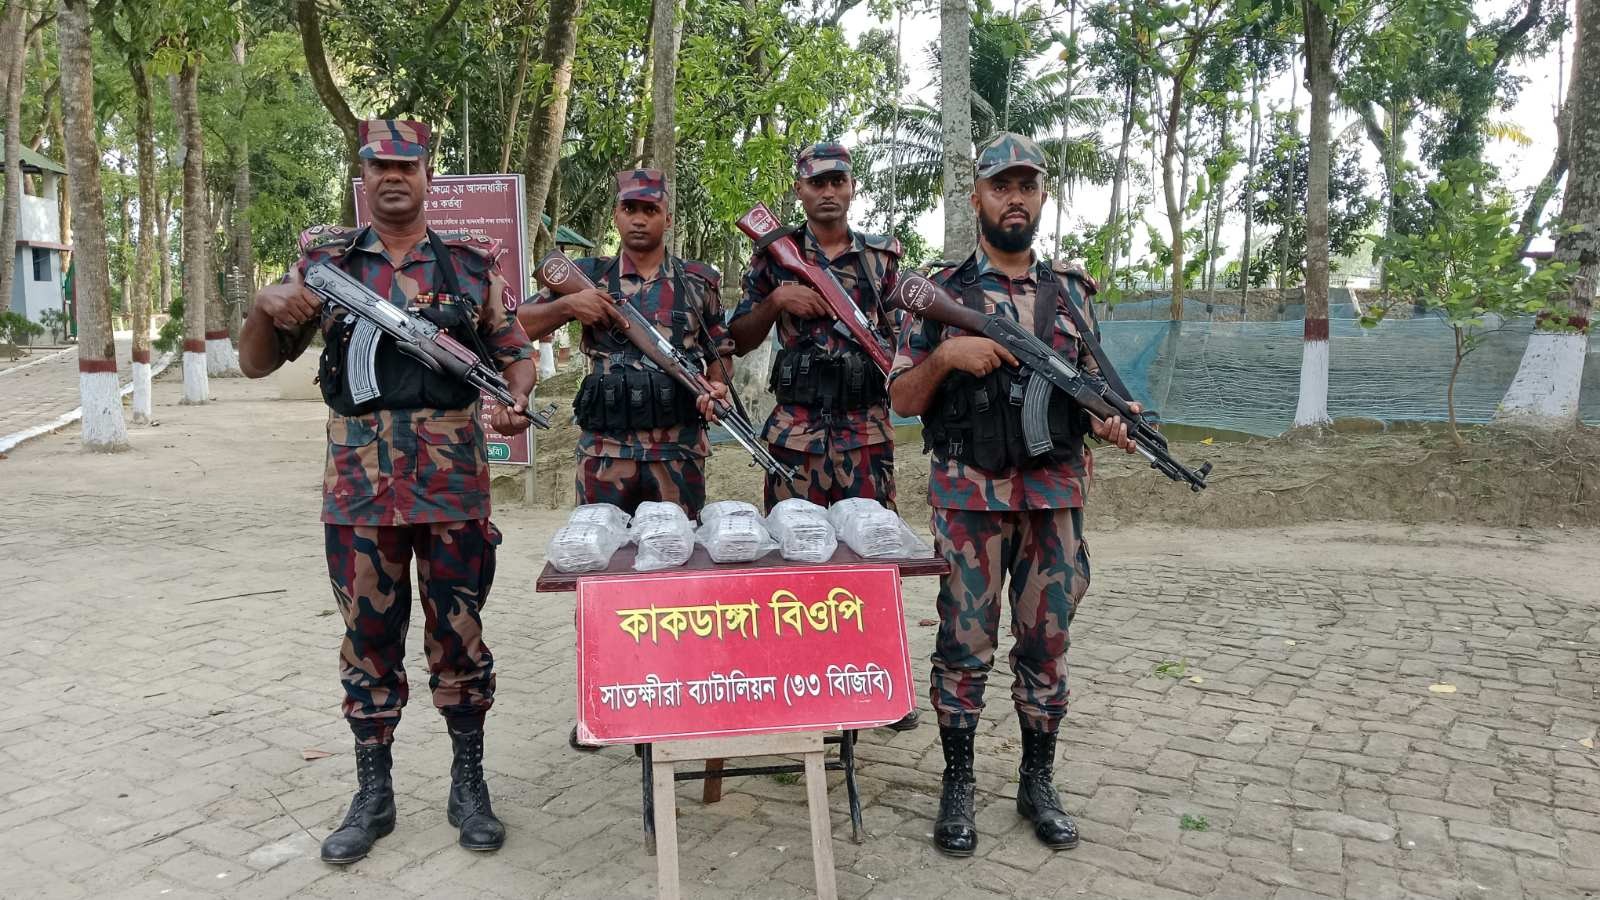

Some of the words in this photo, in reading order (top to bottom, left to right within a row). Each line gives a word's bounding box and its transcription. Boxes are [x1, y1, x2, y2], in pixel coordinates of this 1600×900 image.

[616, 598, 761, 645] কাকডাঙ্গা
[768, 588, 864, 637] বিওপি
[600, 673, 683, 710] সাতক্ষীরা
[687, 669, 777, 704] ব্যাটালিয়ন
[784, 673, 821, 706] (৩৩
[826, 663, 893, 700] বিজিবি)
